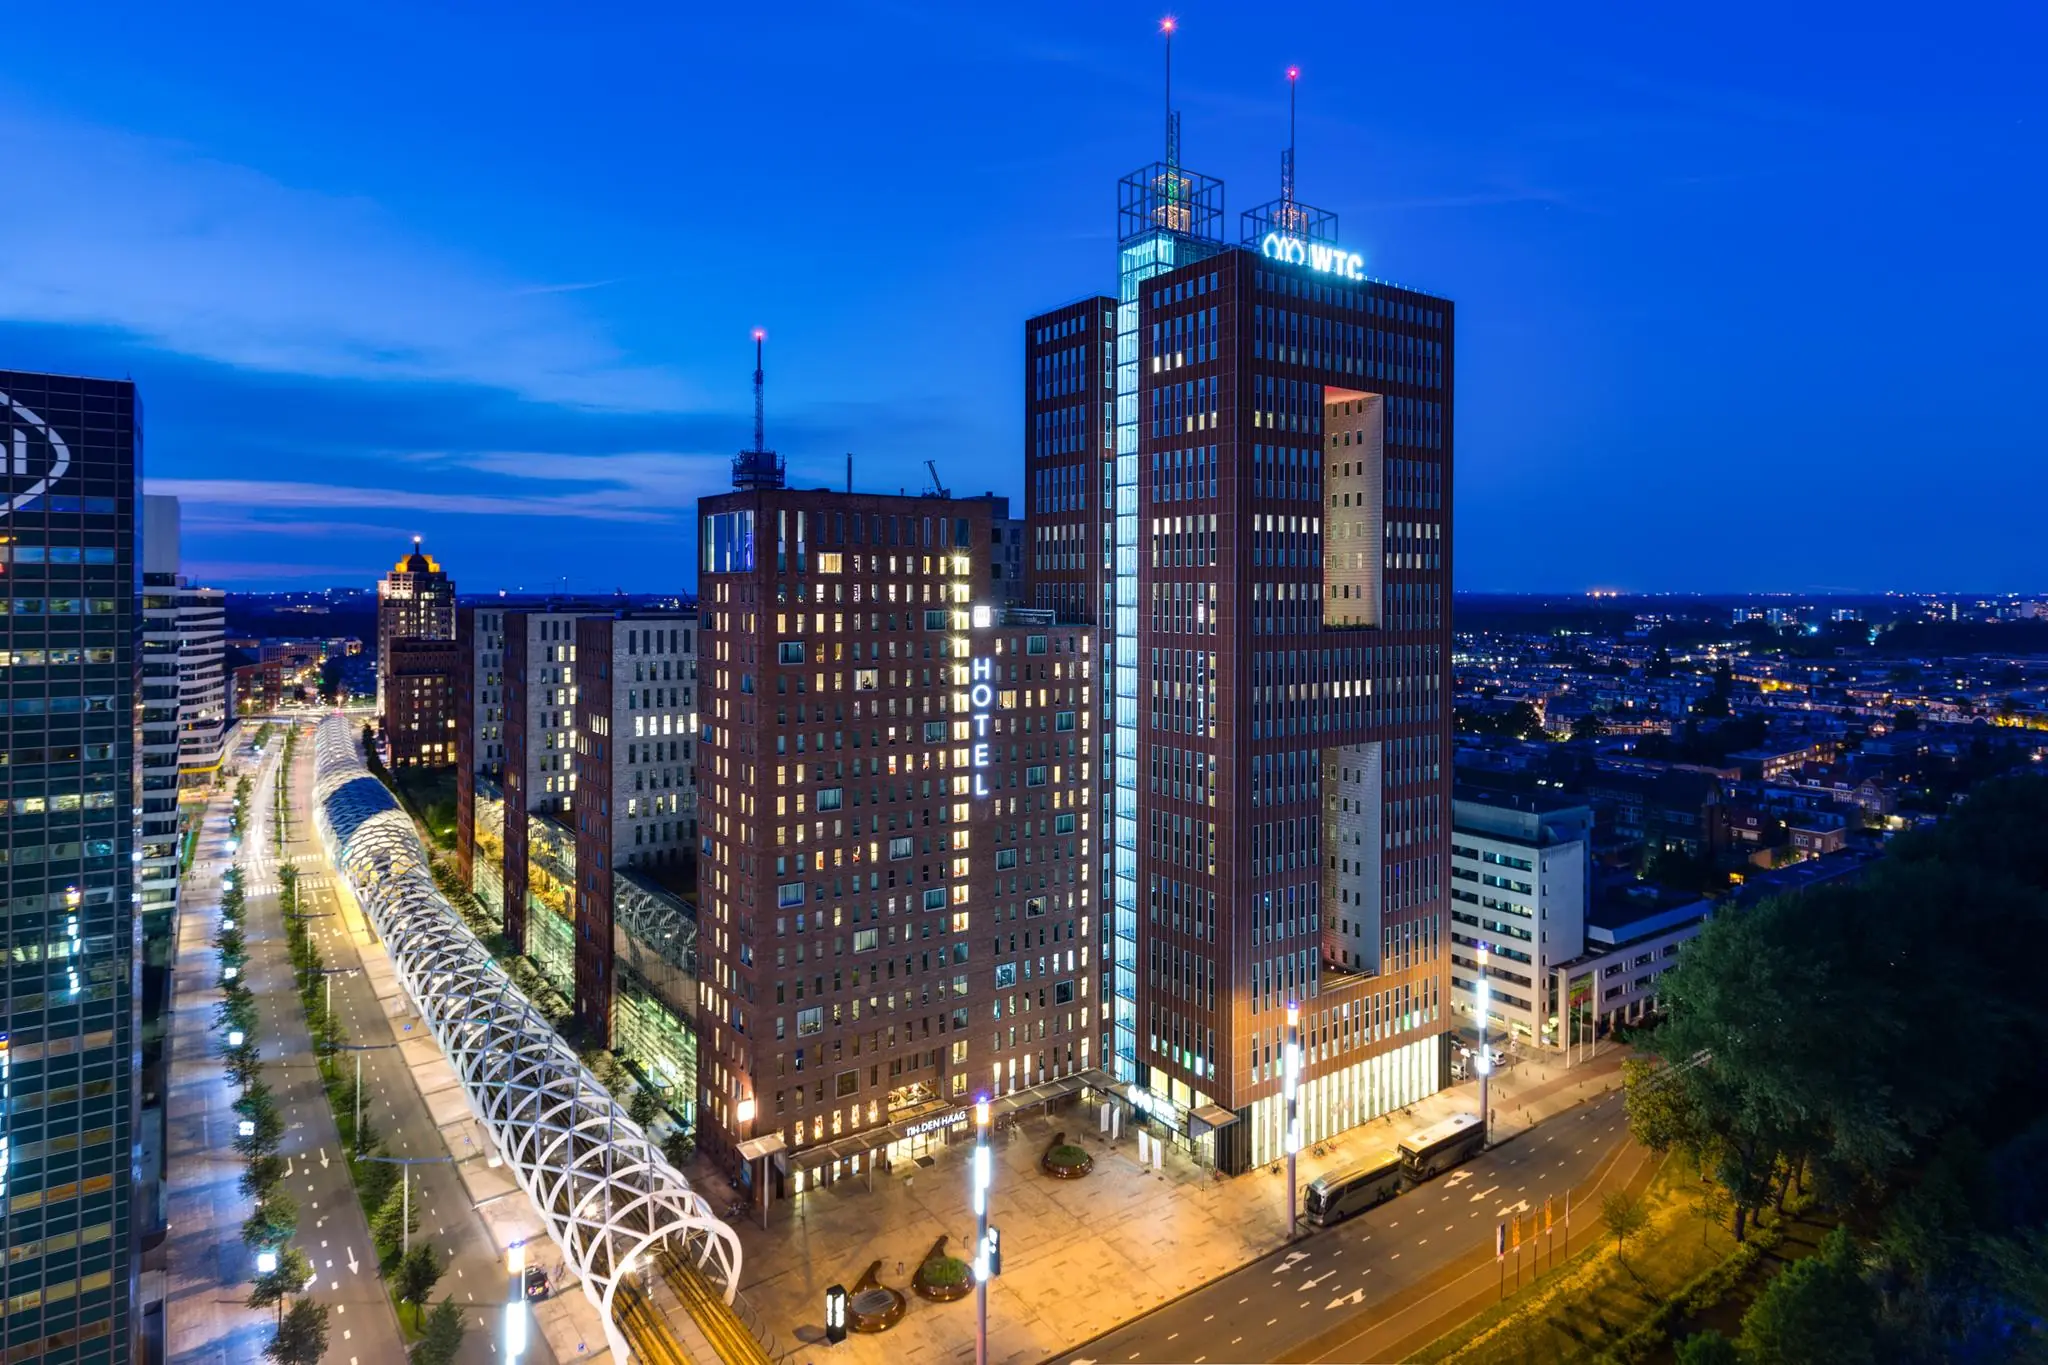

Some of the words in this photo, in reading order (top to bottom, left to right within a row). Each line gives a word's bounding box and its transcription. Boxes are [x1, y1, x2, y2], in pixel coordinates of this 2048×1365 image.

[1310, 243, 1363, 280] WTC
[972, 657, 992, 796] HOTEL
[921, 1118, 940, 1132] DEN
[941, 1111, 966, 1126] HAAG
